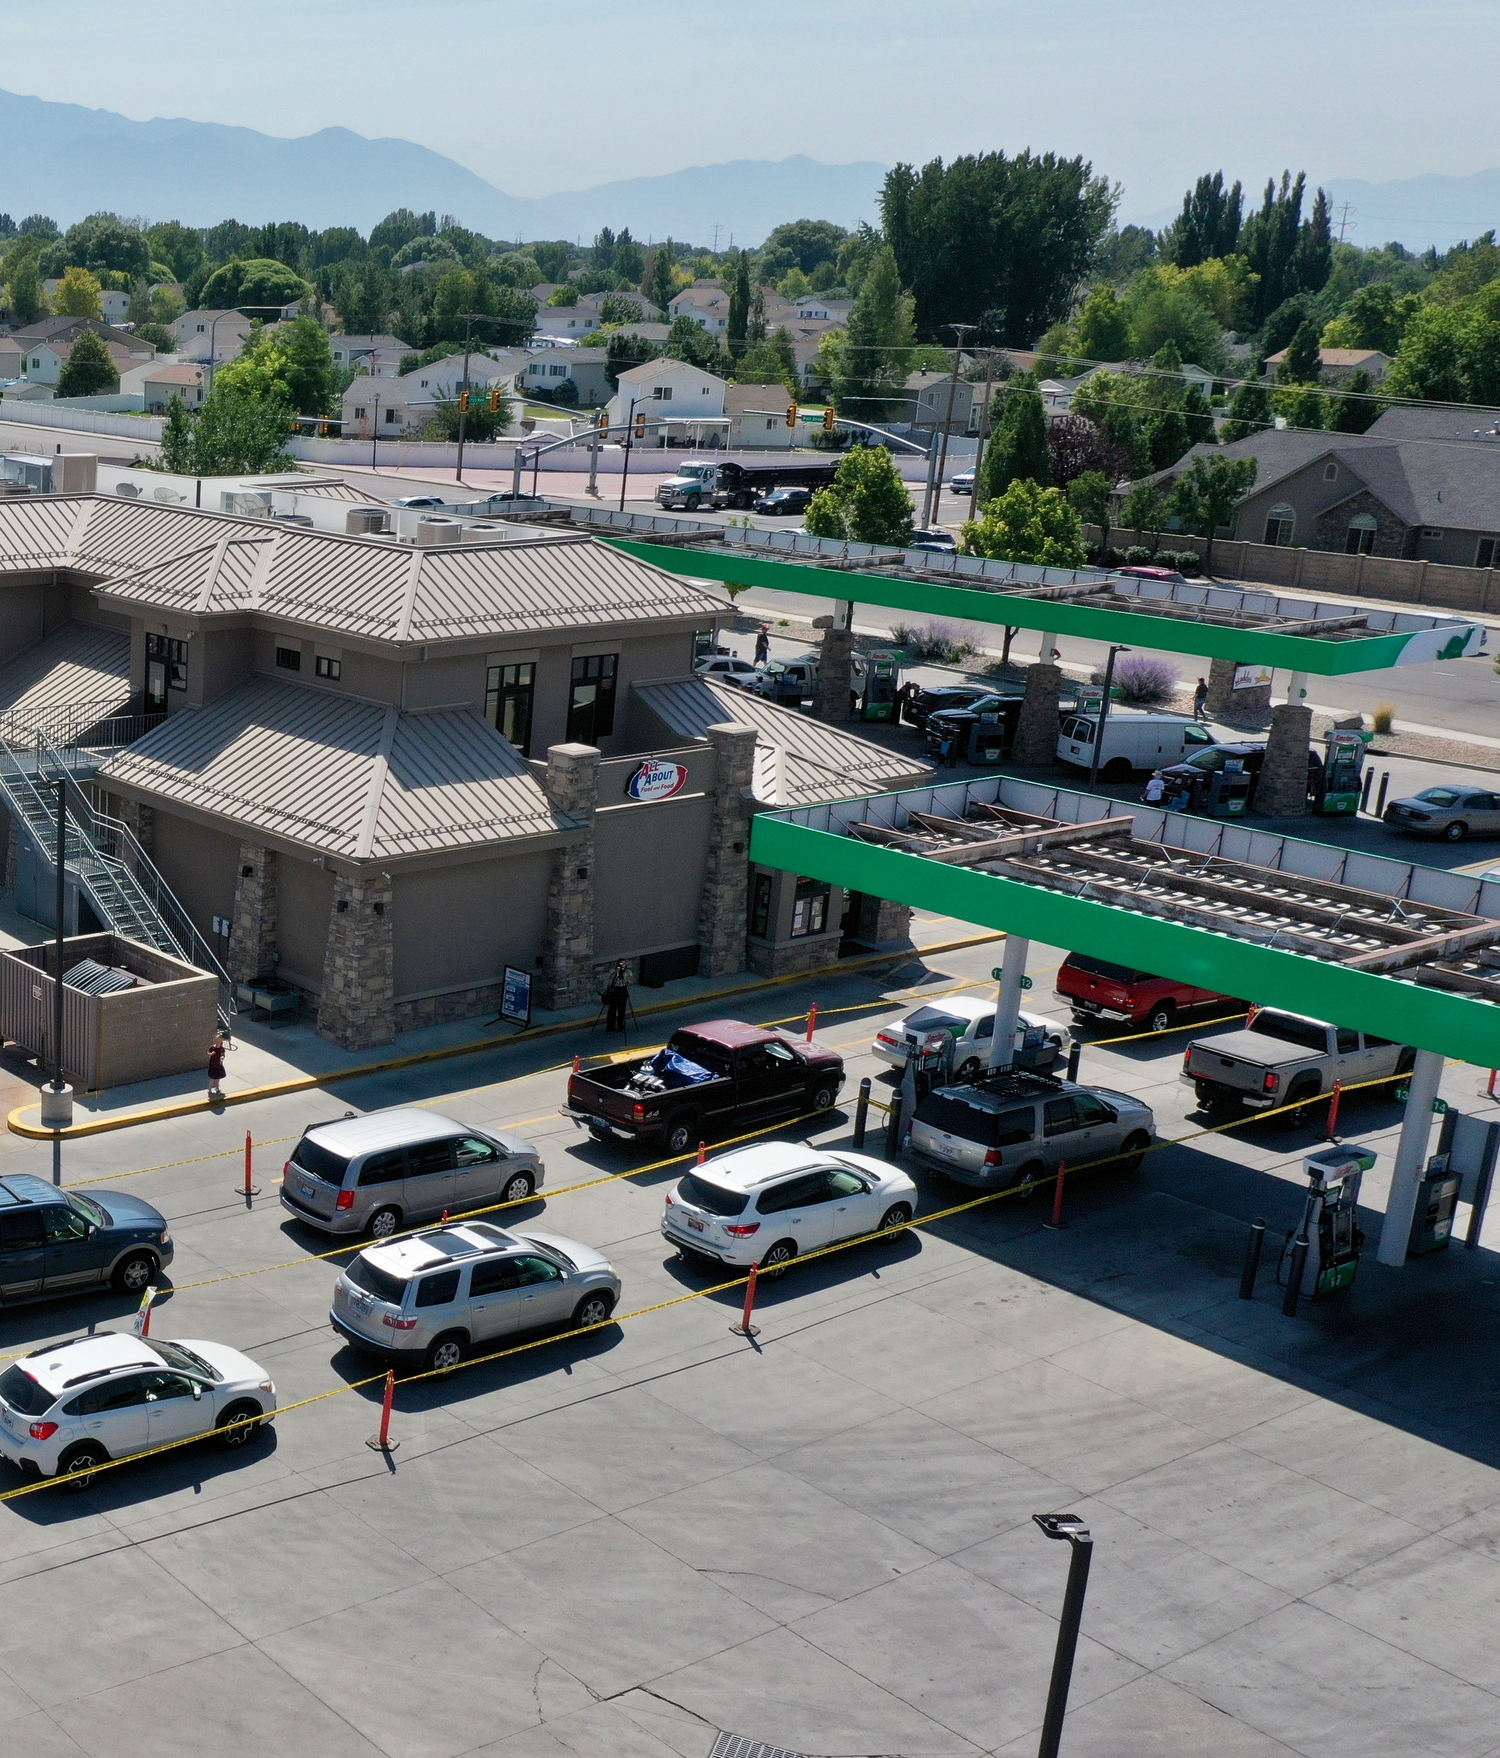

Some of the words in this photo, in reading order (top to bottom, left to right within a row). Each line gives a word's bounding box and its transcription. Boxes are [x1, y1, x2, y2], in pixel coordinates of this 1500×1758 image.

[639, 762, 659, 779] ALL
[643, 770, 674, 786] ABOUT
[660, 782, 674, 790] Food
[1021, 978, 1031, 988] 12
[1396, 1089, 1409, 1100] 13
[1434, 1101, 1446, 1113] 14
